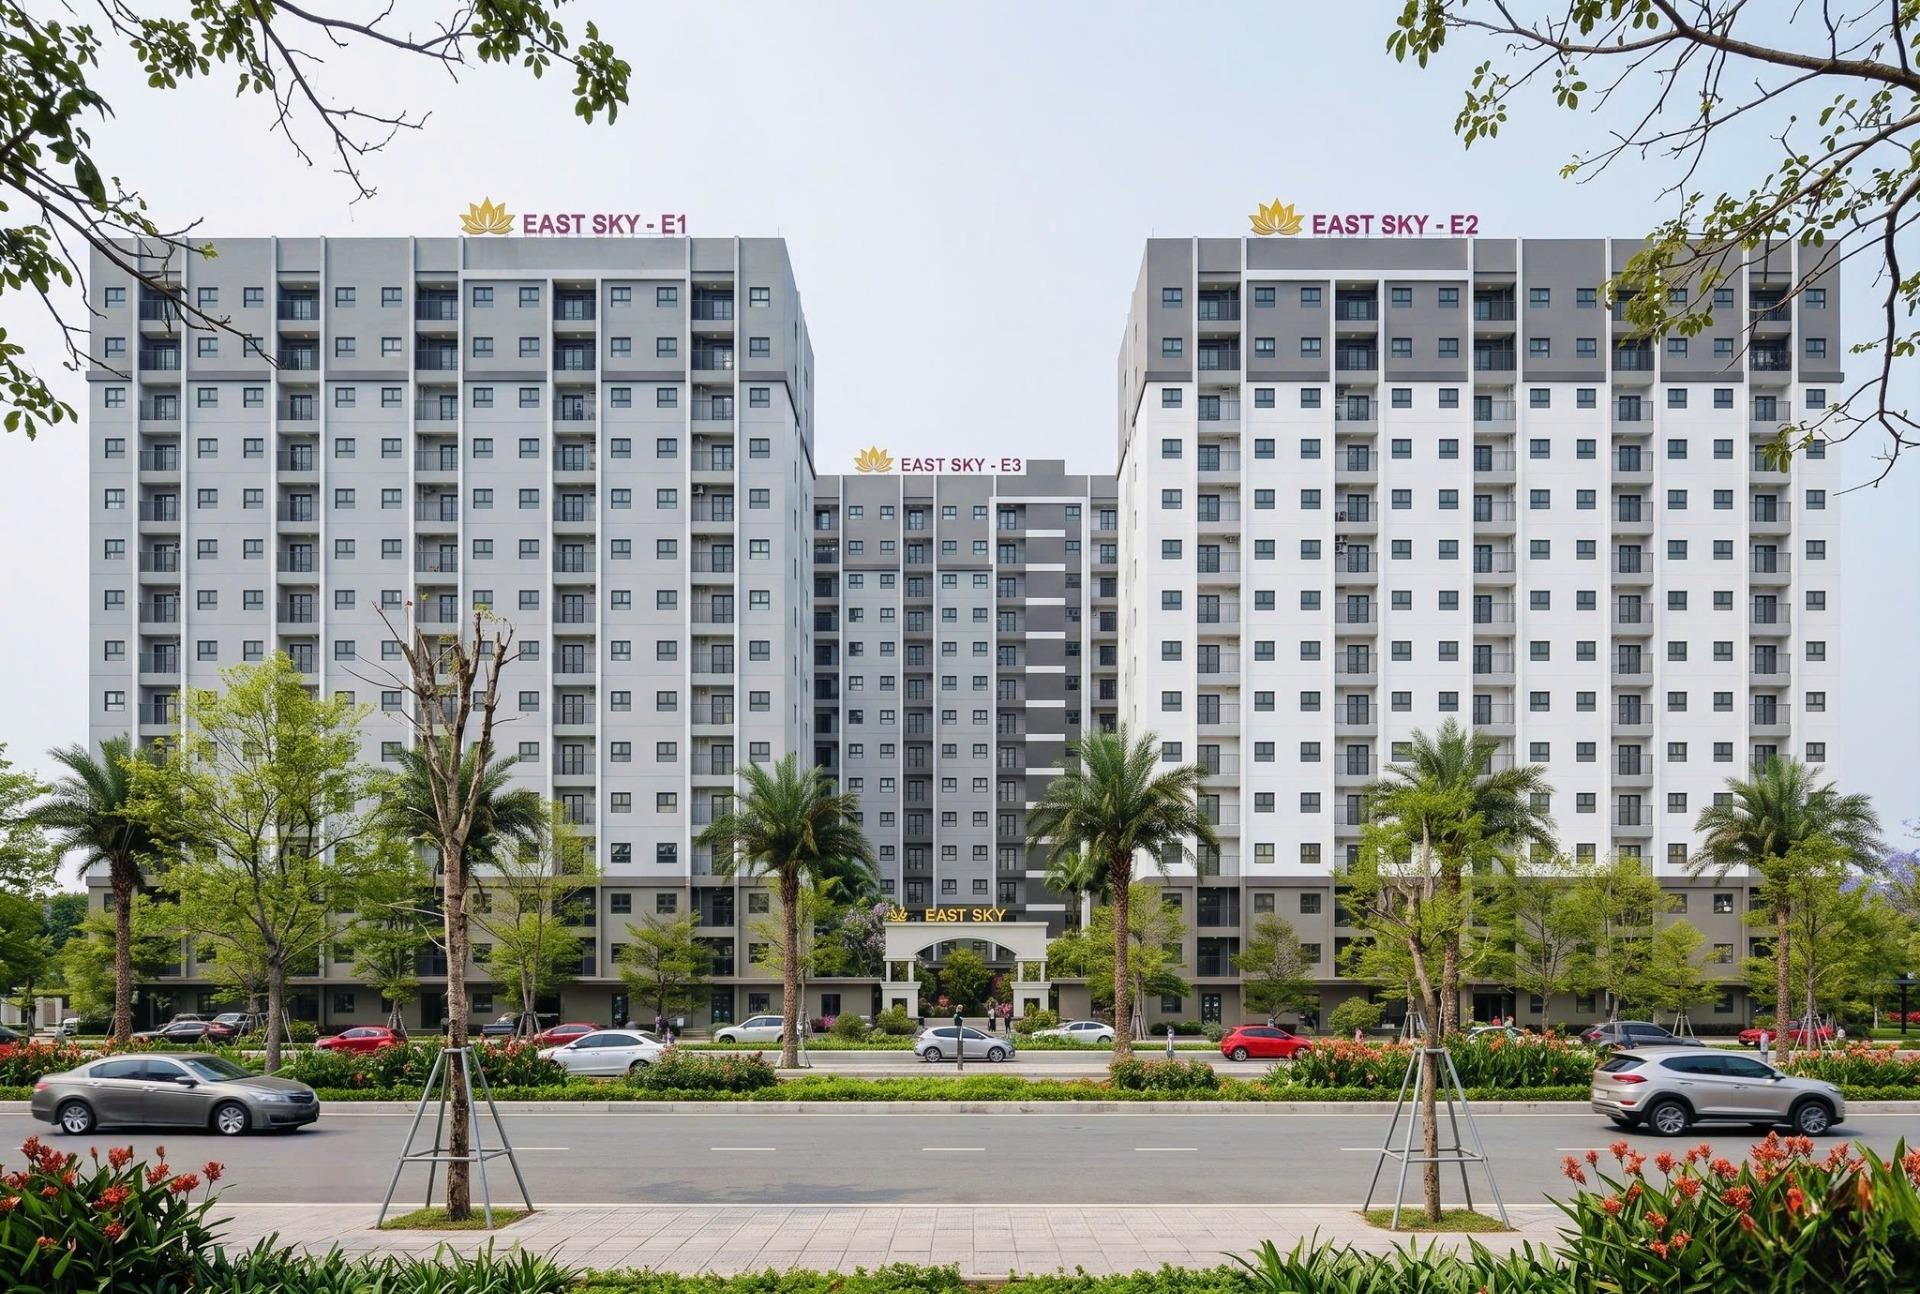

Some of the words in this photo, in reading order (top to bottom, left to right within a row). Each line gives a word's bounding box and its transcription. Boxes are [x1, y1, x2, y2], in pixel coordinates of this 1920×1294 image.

[523, 214, 586, 234] EAST
[592, 214, 641, 234] SKY
[661, 214, 686, 234] E1
[1312, 215, 1375, 234] EAST
[1381, 215, 1430, 234] SKY
[1450, 215, 1479, 234] E2
[901, 458, 946, 472] EAST
[951, 458, 985, 472] SKY
[1001, 458, 1022, 472] E3
[925, 908, 967, 922] EAST
[972, 908, 1007, 922] SKY
